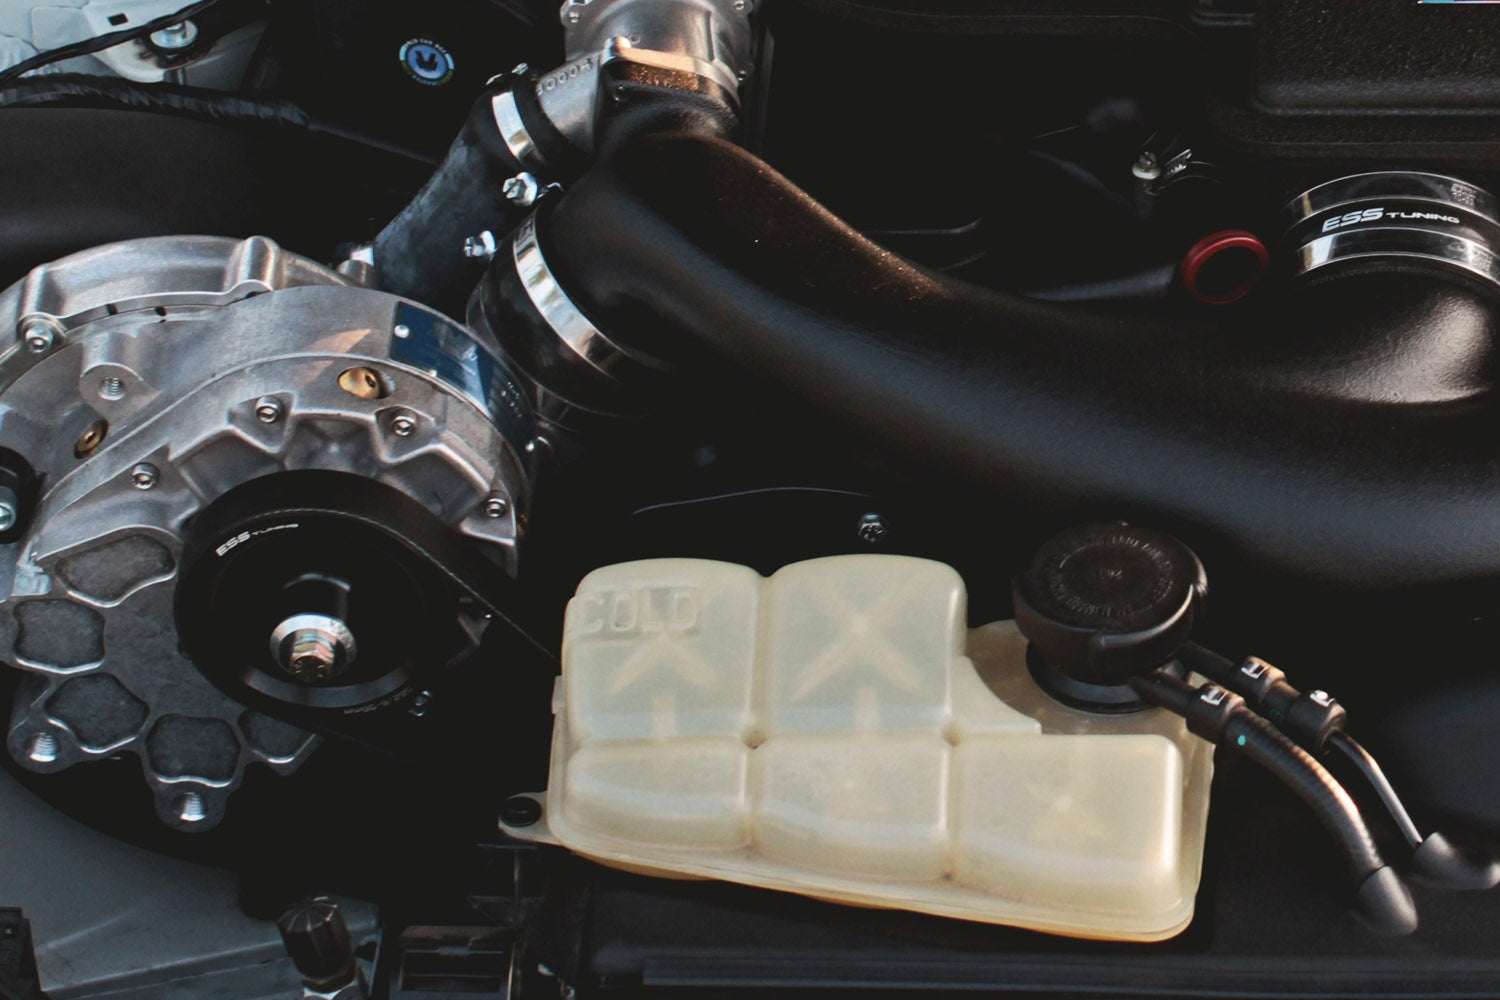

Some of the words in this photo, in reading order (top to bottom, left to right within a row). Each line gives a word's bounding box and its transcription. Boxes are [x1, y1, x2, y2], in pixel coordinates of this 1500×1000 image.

[1322, 207, 1385, 233] ESS
[1386, 211, 1460, 224] TUNING
[215, 530, 251, 557] ESS
[575, 587, 700, 634] COLD
